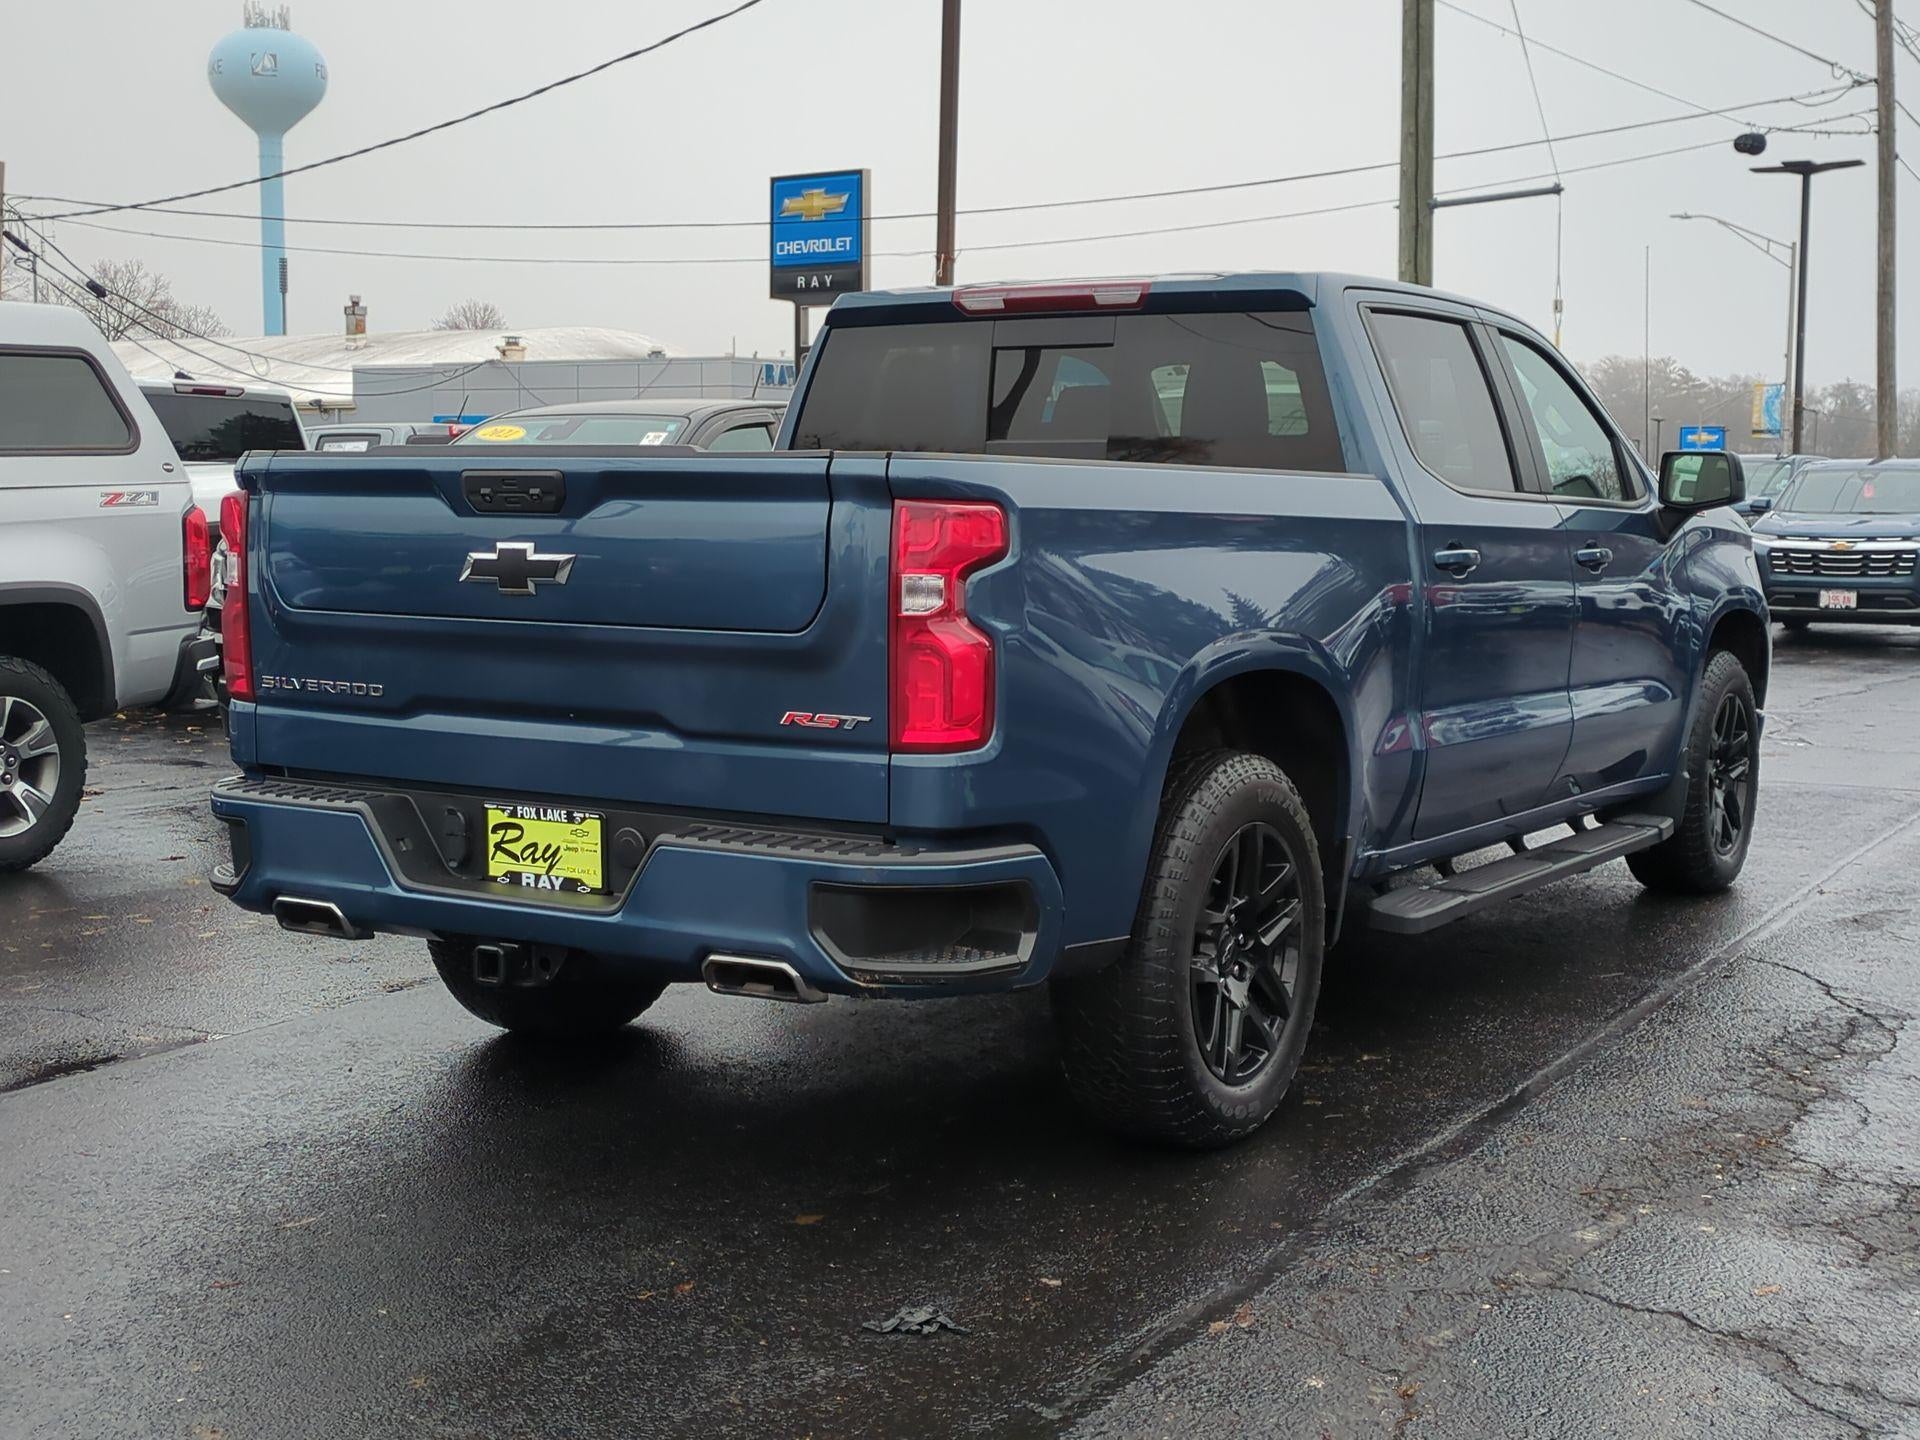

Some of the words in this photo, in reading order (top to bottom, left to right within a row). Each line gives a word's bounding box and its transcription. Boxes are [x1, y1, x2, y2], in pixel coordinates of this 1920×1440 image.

[776, 237, 852, 255] CHEVROLET
[797, 274, 832, 288] RAY
[100, 490, 159, 507] Z71
[261, 675, 384, 697] SILVERADO
[780, 711, 872, 730] RST
[516, 806, 537, 820] FOX
[540, 808, 568, 823] LAKE
[490, 821, 563, 875] Ray
[521, 872, 565, 891] RAY
